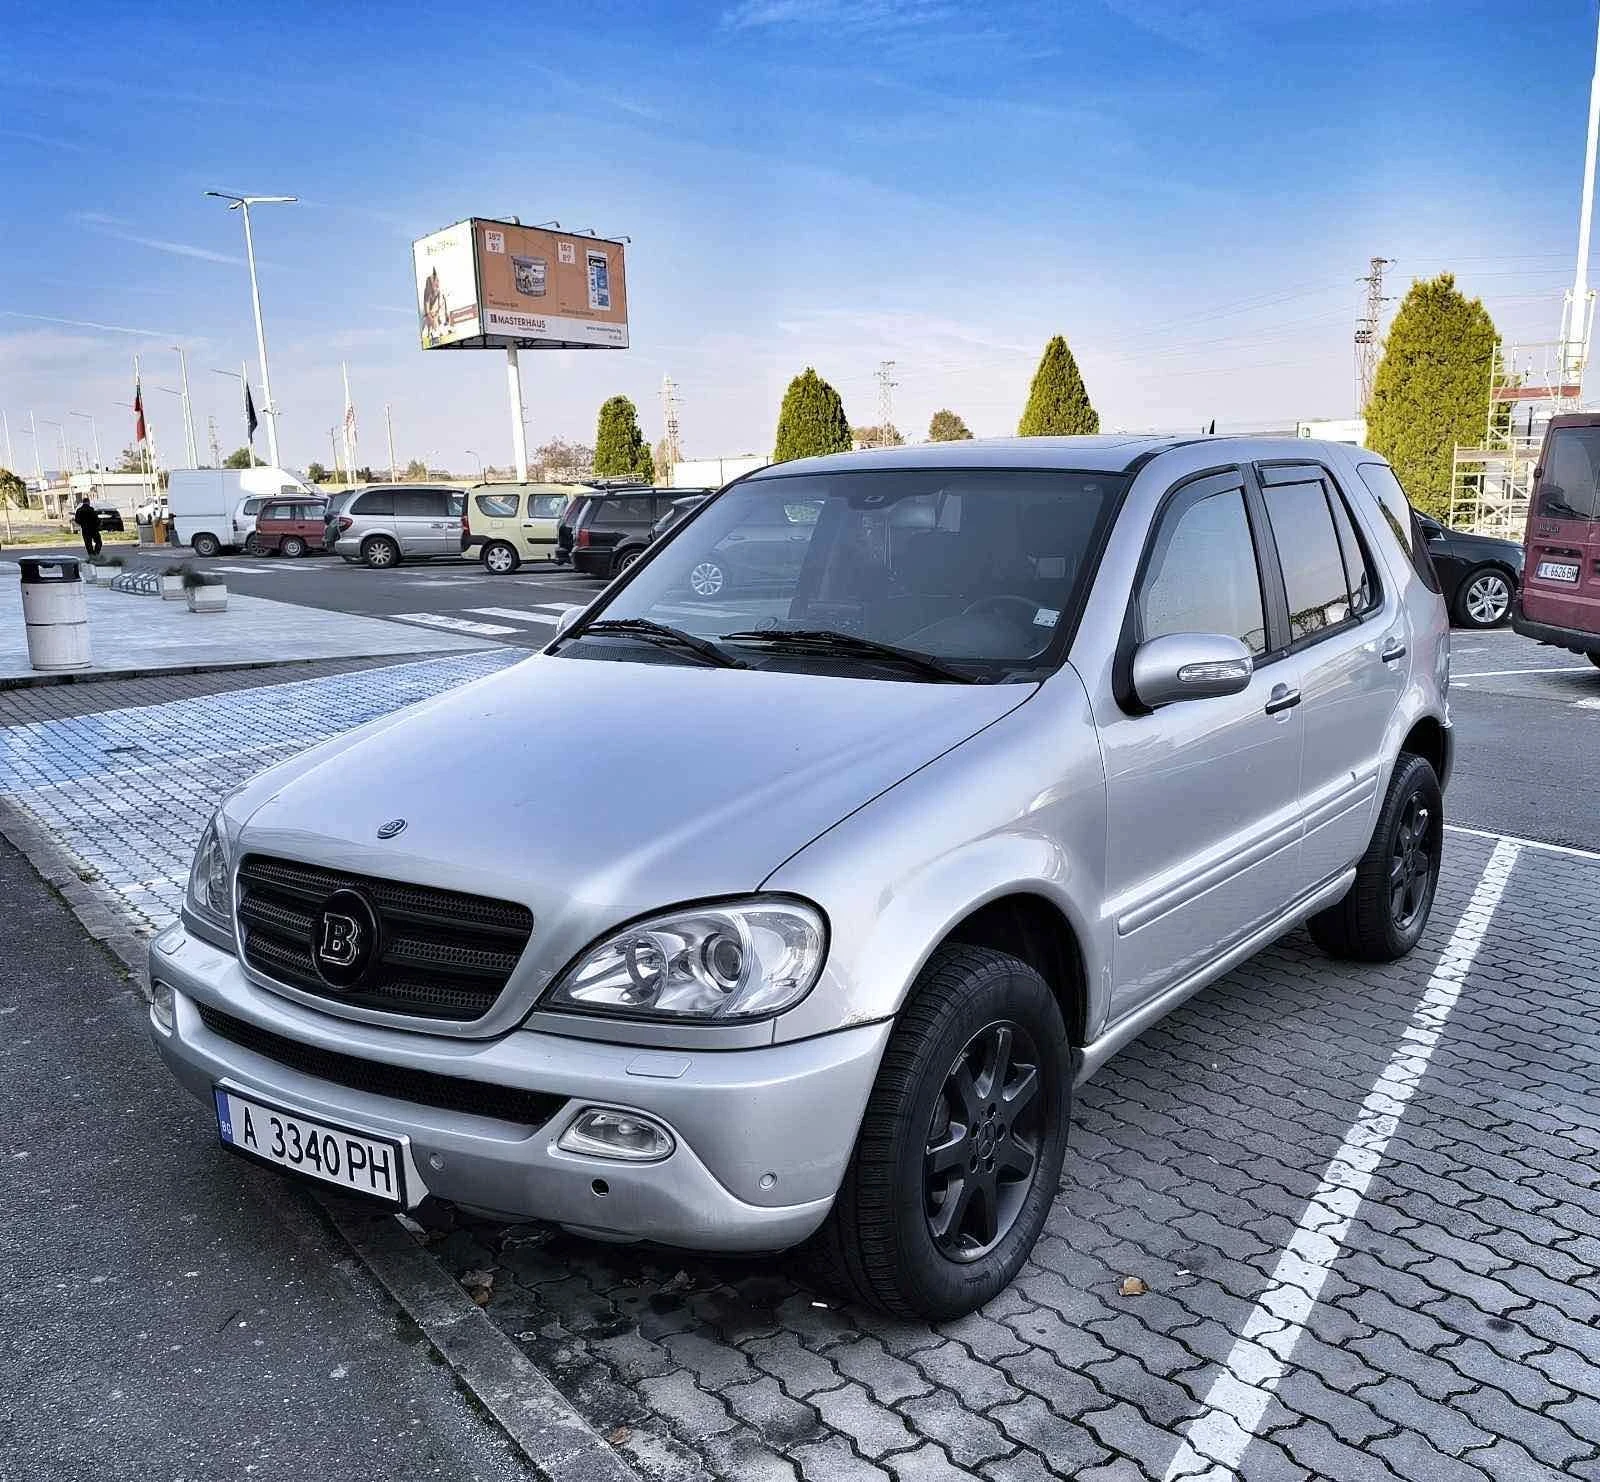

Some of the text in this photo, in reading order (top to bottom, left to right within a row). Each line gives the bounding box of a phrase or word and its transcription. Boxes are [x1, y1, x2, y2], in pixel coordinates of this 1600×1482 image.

[498, 314, 546, 329] MASTERHAUS
[319, 911, 361, 967] B
[244, 1106, 392, 1193] A 3340 PH
